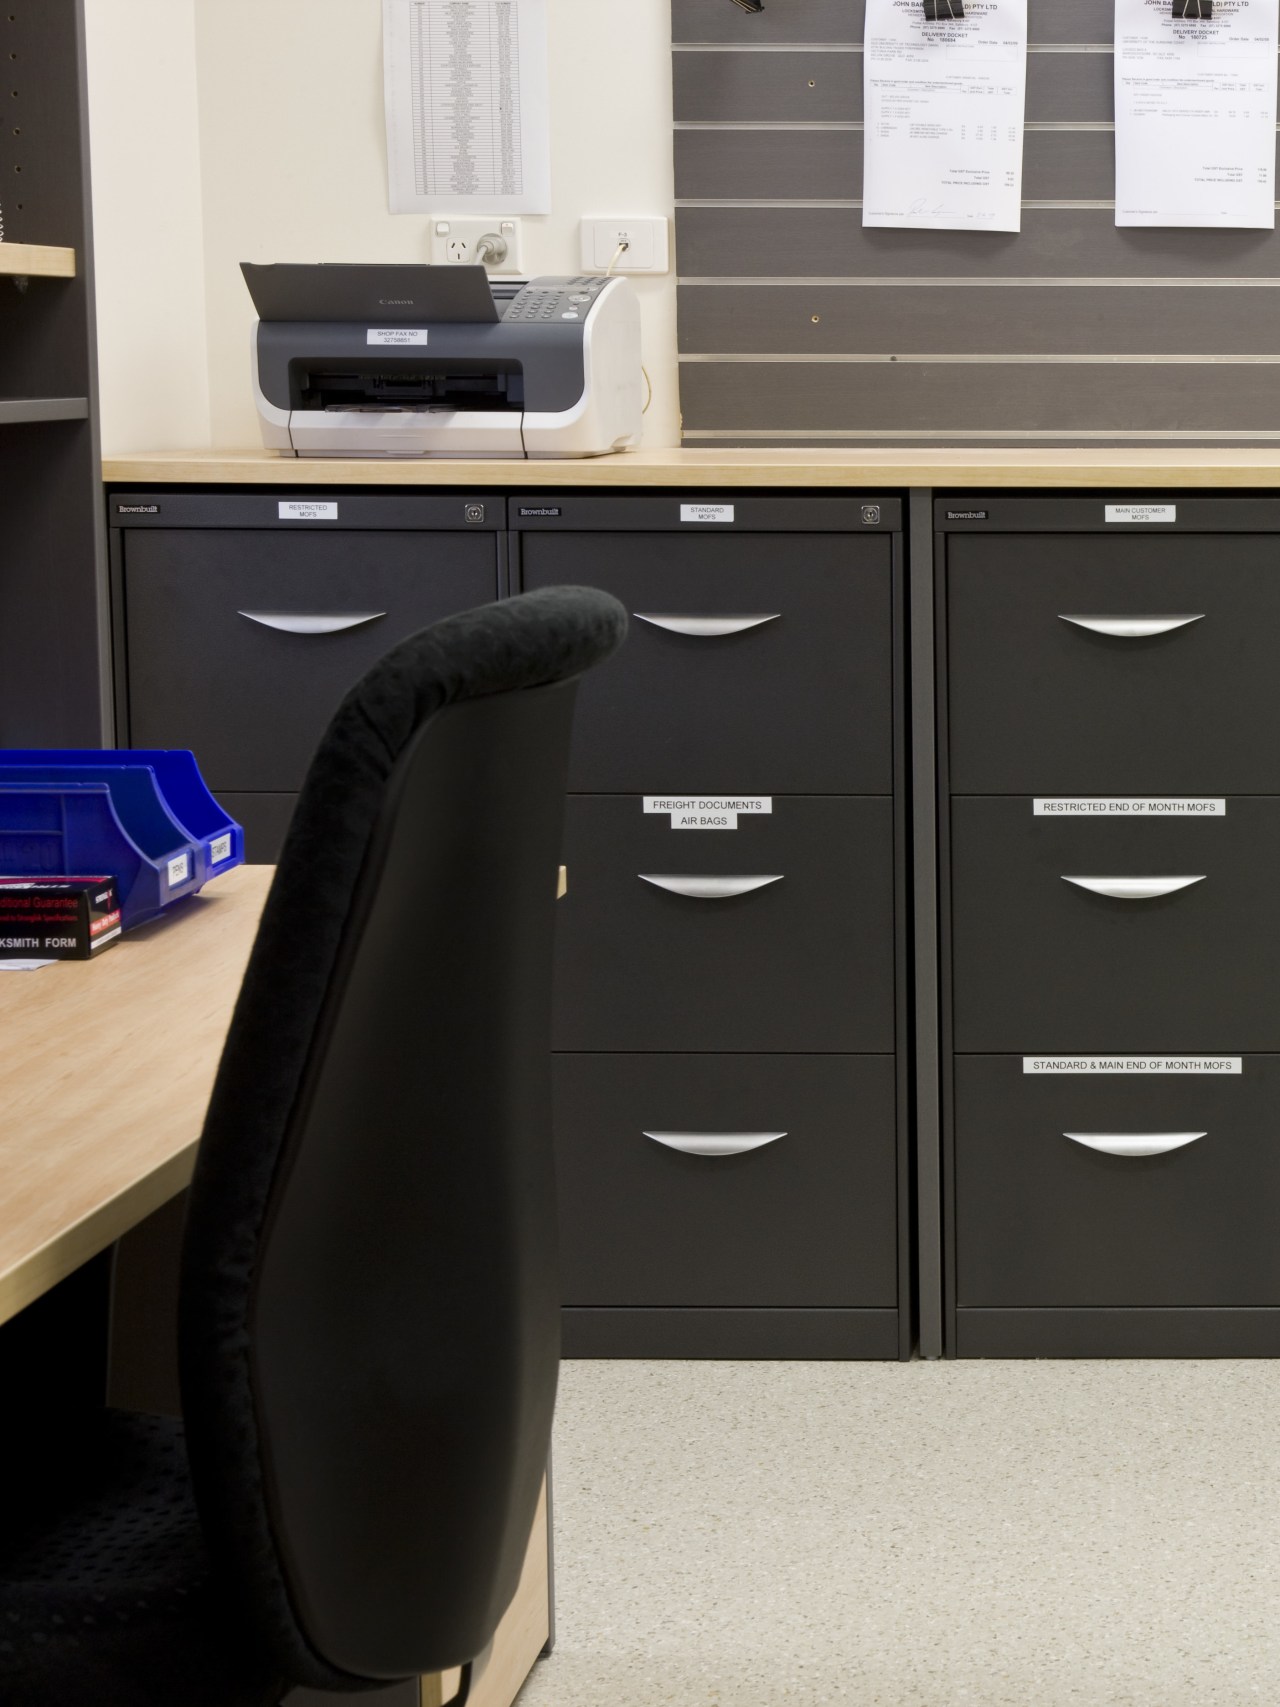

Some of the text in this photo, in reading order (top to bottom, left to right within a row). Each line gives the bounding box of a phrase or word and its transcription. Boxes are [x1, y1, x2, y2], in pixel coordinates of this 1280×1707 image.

[119, 505, 158, 513] Brownbuilt
[948, 511, 986, 519] Brownbuilt
[653, 801, 762, 810] FREIGHT DOCUMENTS
[1043, 803, 1216, 812] RESTRICTED END OF MONTH MOFS
[680, 816, 728, 825] AIR BAGS
[33, 896, 78, 909] Guarantee
[45, 938, 77, 948] FORM
[1033, 1061, 1232, 1071] STANDARD & MAIN END OF MONTH MOFS
